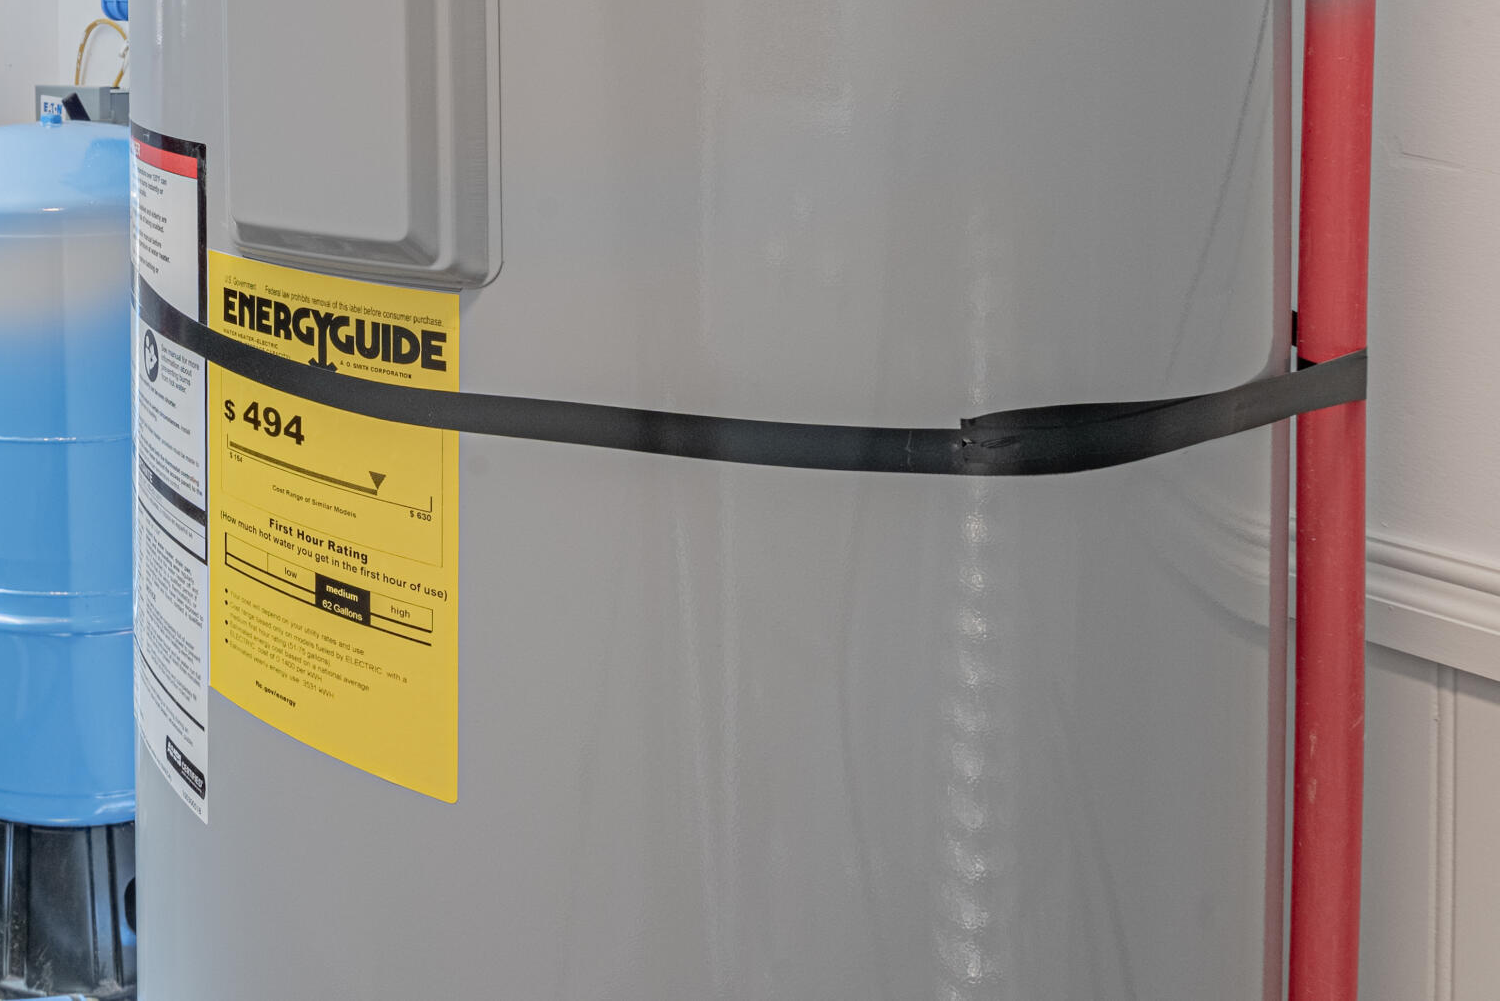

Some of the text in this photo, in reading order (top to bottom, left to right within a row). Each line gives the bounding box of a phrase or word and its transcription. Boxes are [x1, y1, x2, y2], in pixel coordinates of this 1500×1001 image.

[350, 303, 363, 314] label
[364, 305, 382, 318] before
[382, 310, 412, 322] consumer
[223, 286, 447, 373] ENERGYGUIDE
[370, 366, 412, 379] CORPORATION
[223, 398, 236, 424] $
[243, 400, 306, 446] 494
[271, 484, 357, 518] Cost Range of Similar Models
[409, 510, 432, 522] $ 630
[269, 518, 369, 565] First Hour Rating
[220, 510, 449, 602] (How much hot water you get in the first hour of use)
[284, 566, 298, 580] low
[325, 584, 359, 603] medium
[321, 599, 364, 621] 62 Gallons
[390, 604, 411, 619] high
